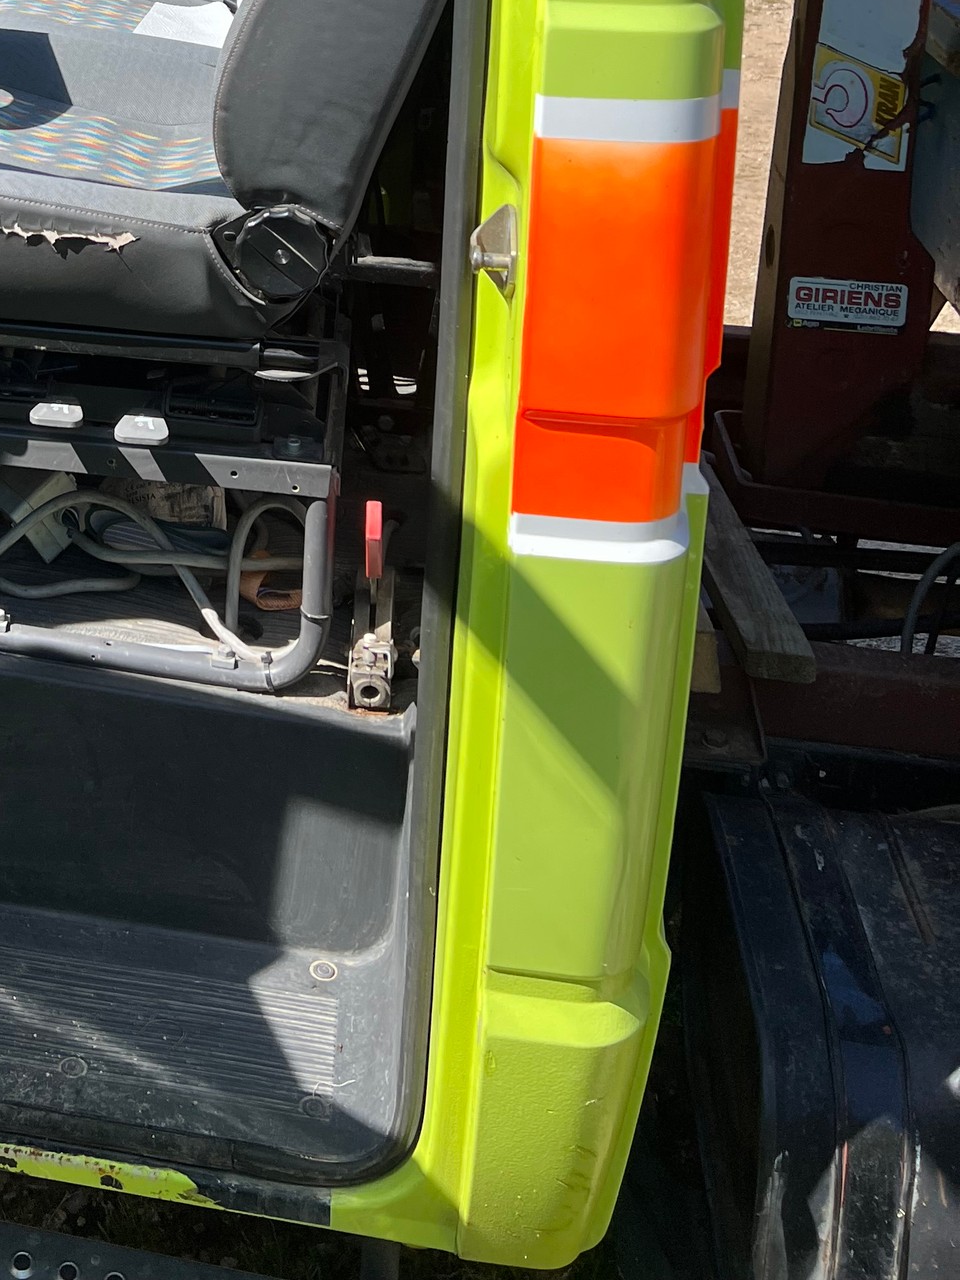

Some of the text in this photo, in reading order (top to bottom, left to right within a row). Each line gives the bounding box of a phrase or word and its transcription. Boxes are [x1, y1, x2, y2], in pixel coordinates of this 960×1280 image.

[849, 282, 903, 293] CHRISTIAN
[795, 286, 901, 309] GIRIENS
[794, 302, 834, 312] ATELIER
